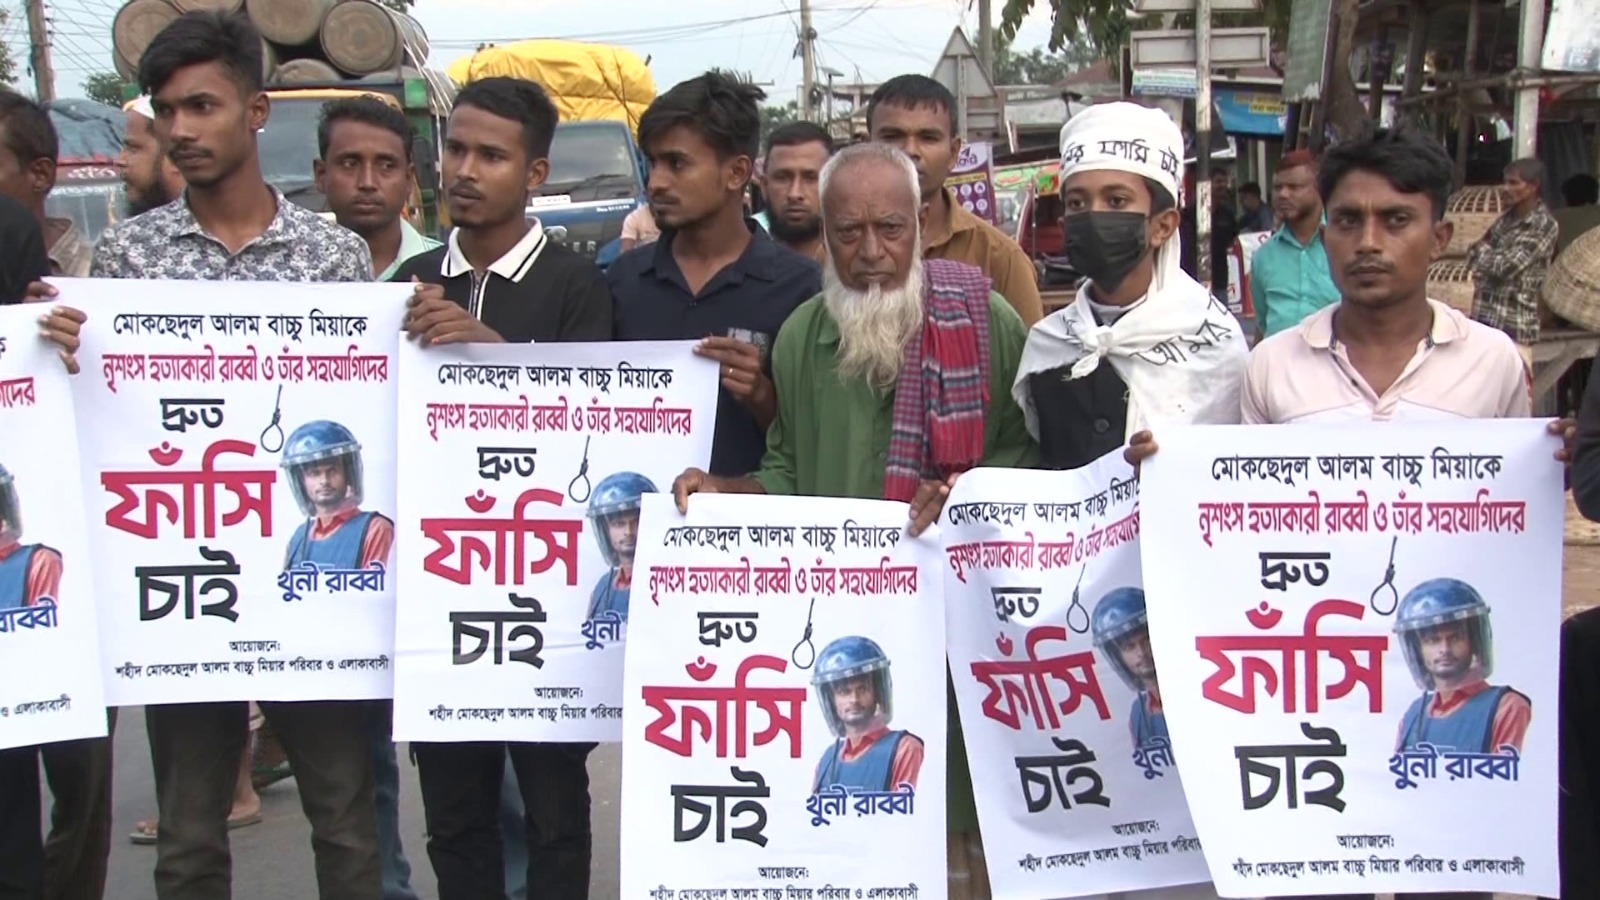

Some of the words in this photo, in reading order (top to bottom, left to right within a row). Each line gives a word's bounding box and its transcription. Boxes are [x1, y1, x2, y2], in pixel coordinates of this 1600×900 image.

[114, 313, 203, 342] মোকছেদুল
[211, 314, 260, 335] আলম
[268, 315, 303, 342] বাচ্চু
[309, 309, 368, 336] মিয়াকে
[102, 353, 145, 394] নৃশংস
[149, 345, 214, 382] হত্যাকারী
[219, 345, 257, 382] রাব্বী
[262, 354, 274, 380] ও
[278, 345, 303, 382] তাঁর
[307, 345, 388, 382] সহযোগিদের
[438, 363, 520, 390] মোকছেদুল
[526, 365, 572, 386] আলম
[579, 367, 611, 393] বাচ্চু
[618, 362, 673, 389] মিয়াকে
[160, 399, 224, 432] দ্রুত
[426, 403, 465, 440] নৃশংস
[469, 395, 529, 432] হত্যাকারী
[532, 396, 568, 432] রাব্বী
[571, 405, 582, 432] ও
[587, 397, 610, 433] তাঁর
[614, 397, 691, 436] সহযোগিদের
[477, 447, 536, 480] দ্রুত
[1212, 456, 1311, 485] মোকছেদুল
[1317, 454, 1374, 480] আলম
[1382, 454, 1424, 485] বাচ্চু
[1432, 447, 1503, 480] মিয়াকে
[101, 439, 276, 539] ফাঁসি
[948, 500, 1026, 527] মোকছেদুল
[1033, 502, 1081, 523] আলম
[1085, 490, 1108, 519] বাচ্চু
[1111, 478, 1139, 507] মিয়াে
[421, 488, 582, 586] ফাঁসি
[663, 525, 742, 552] মোকছেদুল
[748, 525, 796, 546] আলম
[802, 527, 837, 553] বাচ্চু
[843, 520, 902, 546] মিয়াকে
[1199, 501, 1244, 546] নৃশংস
[1248, 491, 1320, 532] হত্যাকারী
[1325, 490, 1369, 534] রাব্বী
[1373, 502, 1387, 531] ও
[1392, 489, 1421, 534] তাঁর
[1427, 489, 1525, 533] সহযোগিদের
[1039, 533, 1073, 571] রাব্বী
[1075, 545, 1083, 564] ও
[1259, 552, 1331, 591] দ্রুত
[135, 546, 240, 622] চাই
[278, 562, 319, 601] খুনী
[325, 562, 385, 592] রাব্বী
[650, 565, 685, 606] নৃশংস
[689, 557, 750, 595] হত্যাকারী
[754, 557, 791, 596] রাব্বী
[795, 567, 807, 594] ও
[811, 557, 836, 596] তাঁর
[840, 557, 917, 595] সহযোগিদের
[449, 593, 546, 670] চাই
[581, 611, 620, 649] খুনী
[698, 612, 758, 647] দ্রুত
[115, 664, 142, 678] শহীদ
[147, 664, 197, 678] মোকছেদুল
[202, 662, 229, 674] আলম
[234, 662, 254, 675] বাচ্চু
[258, 658, 284, 673] মিয়ার
[289, 657, 322, 672] পরিবার
[327, 661, 334, 670] ও
[338, 657, 389, 671] এলাকাবাসী
[971, 626, 1111, 730] ফাঁসি
[1195, 599, 1388, 714] ফাঁসি
[429, 705, 453, 721] শহীদ
[457, 706, 504, 722] মোকছেদুল
[508, 707, 534, 720] আলম
[538, 708, 557, 722] বাচ্চু
[561, 702, 586, 720] মিয়ার
[591, 702, 623, 720] পরিবার
[642, 654, 806, 758] ফাঁসি
[1015, 736, 1110, 813] চাই
[1133, 736, 1175, 780] খুনী
[1235, 722, 1347, 814] চাই
[1389, 742, 1437, 790] খুনী
[1445, 743, 1520, 781] রাব্বী
[670, 765, 770, 847] চাই
[806, 784, 847, 826] খুনী
[854, 784, 915, 817] রাব্বী
[855, 890, 863, 900] ও
